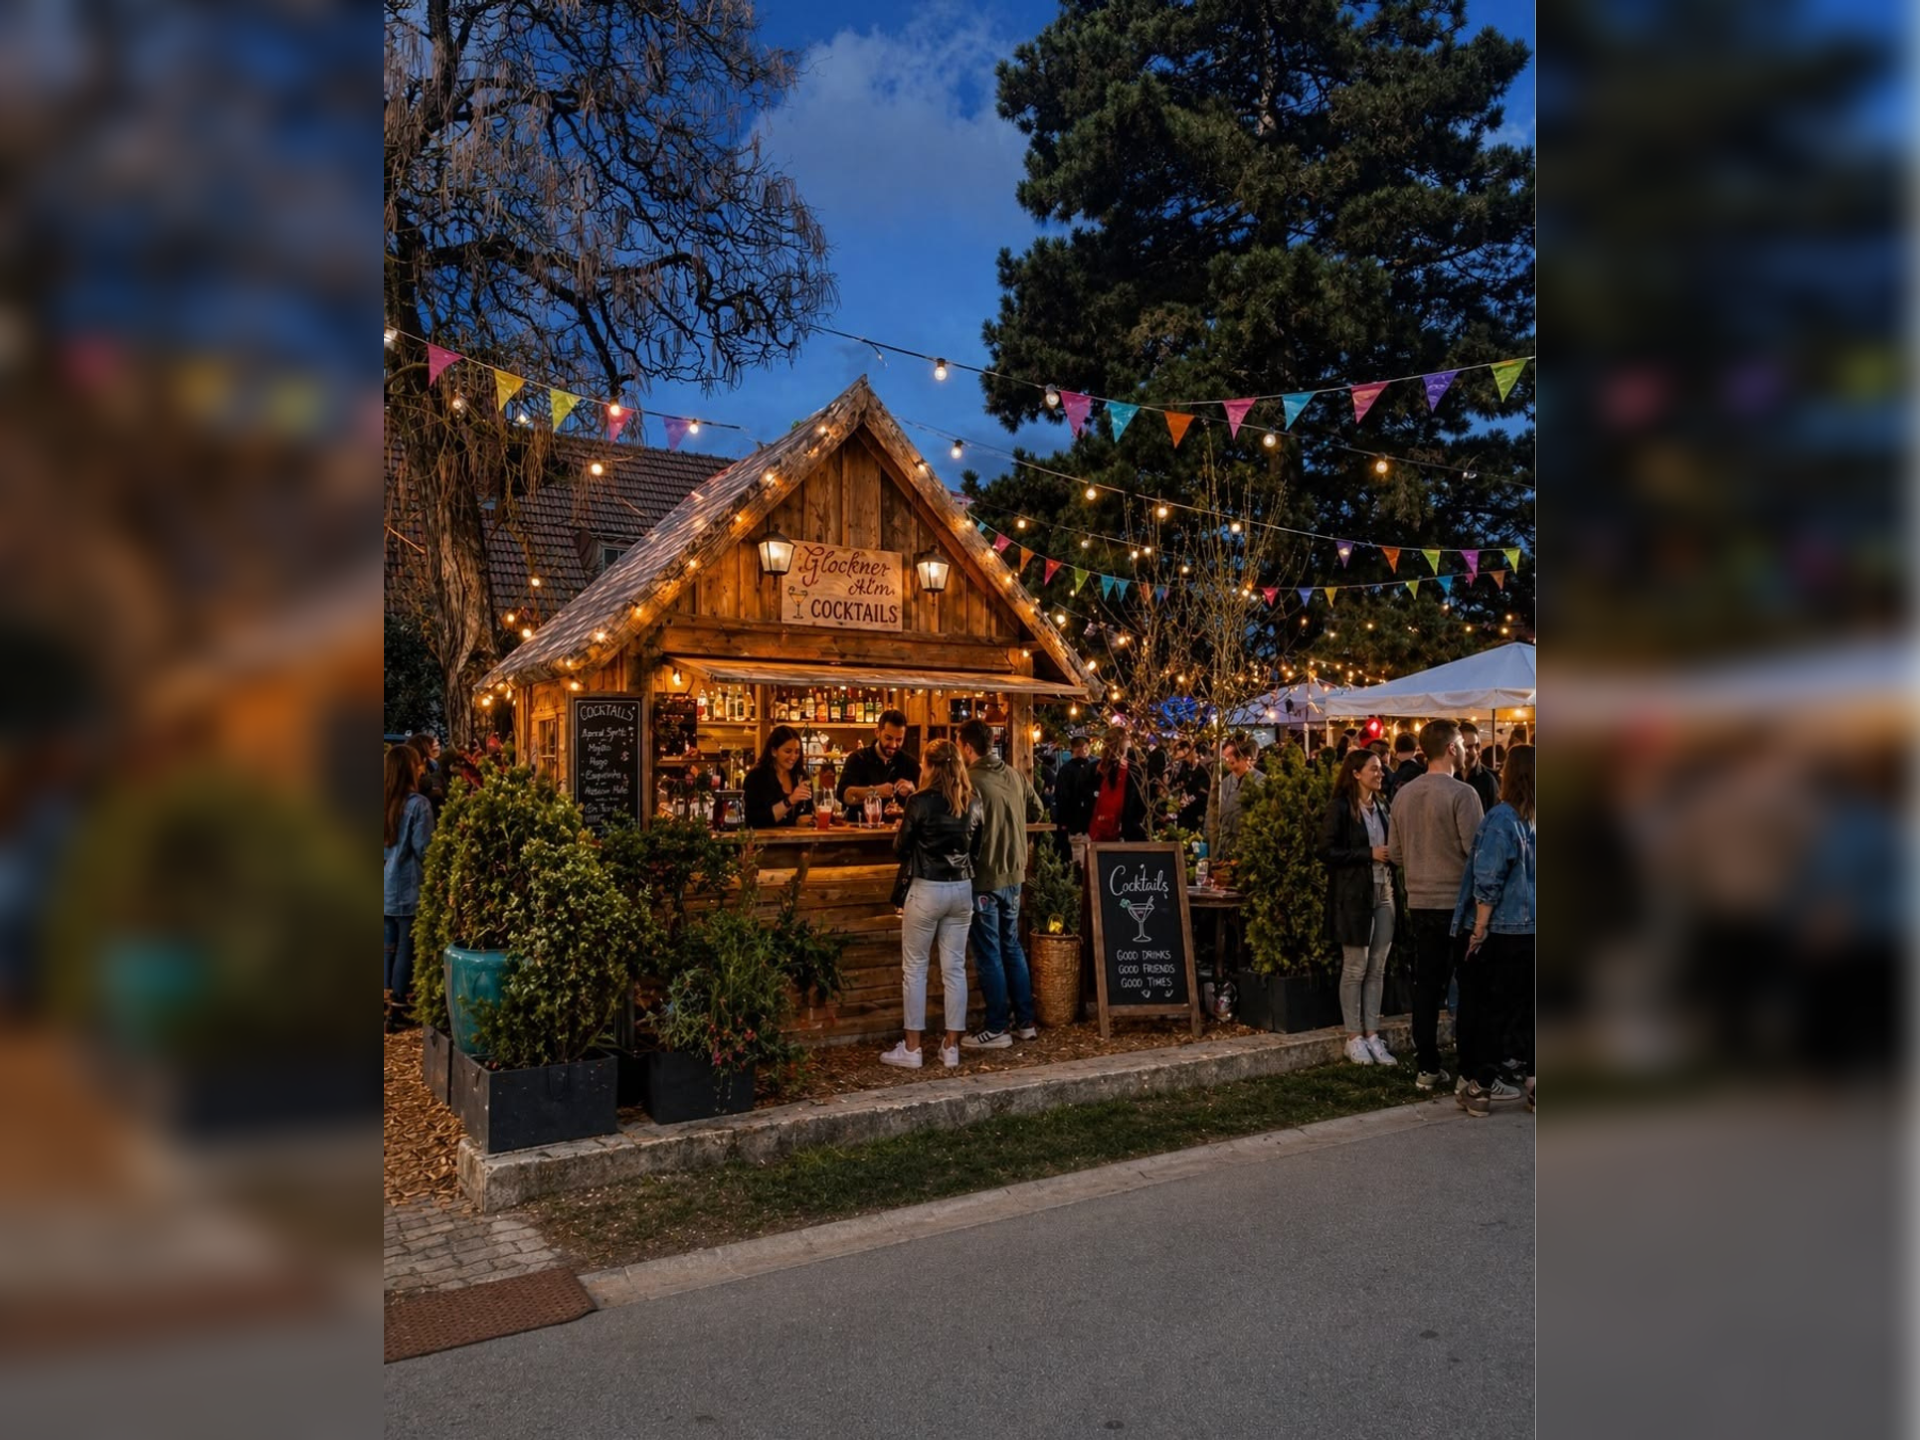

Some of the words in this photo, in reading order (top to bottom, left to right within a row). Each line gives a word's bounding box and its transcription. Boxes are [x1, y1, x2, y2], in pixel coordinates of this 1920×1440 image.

[800, 546, 890, 588] Glockner
[811, 599, 898, 624] COCKTAILS
[580, 704, 634, 721] COCKTAILS
[1109, 864, 1169, 897] Cocktails
[1116, 950, 1138, 961] GOOD
[1142, 950, 1172, 960] DRINKS
[1118, 964, 1139, 974] GOOD
[1143, 963, 1176, 974] FRIENDS
[1120, 978, 1143, 988] GOOD
[1147, 977, 1173, 987] TIMES
